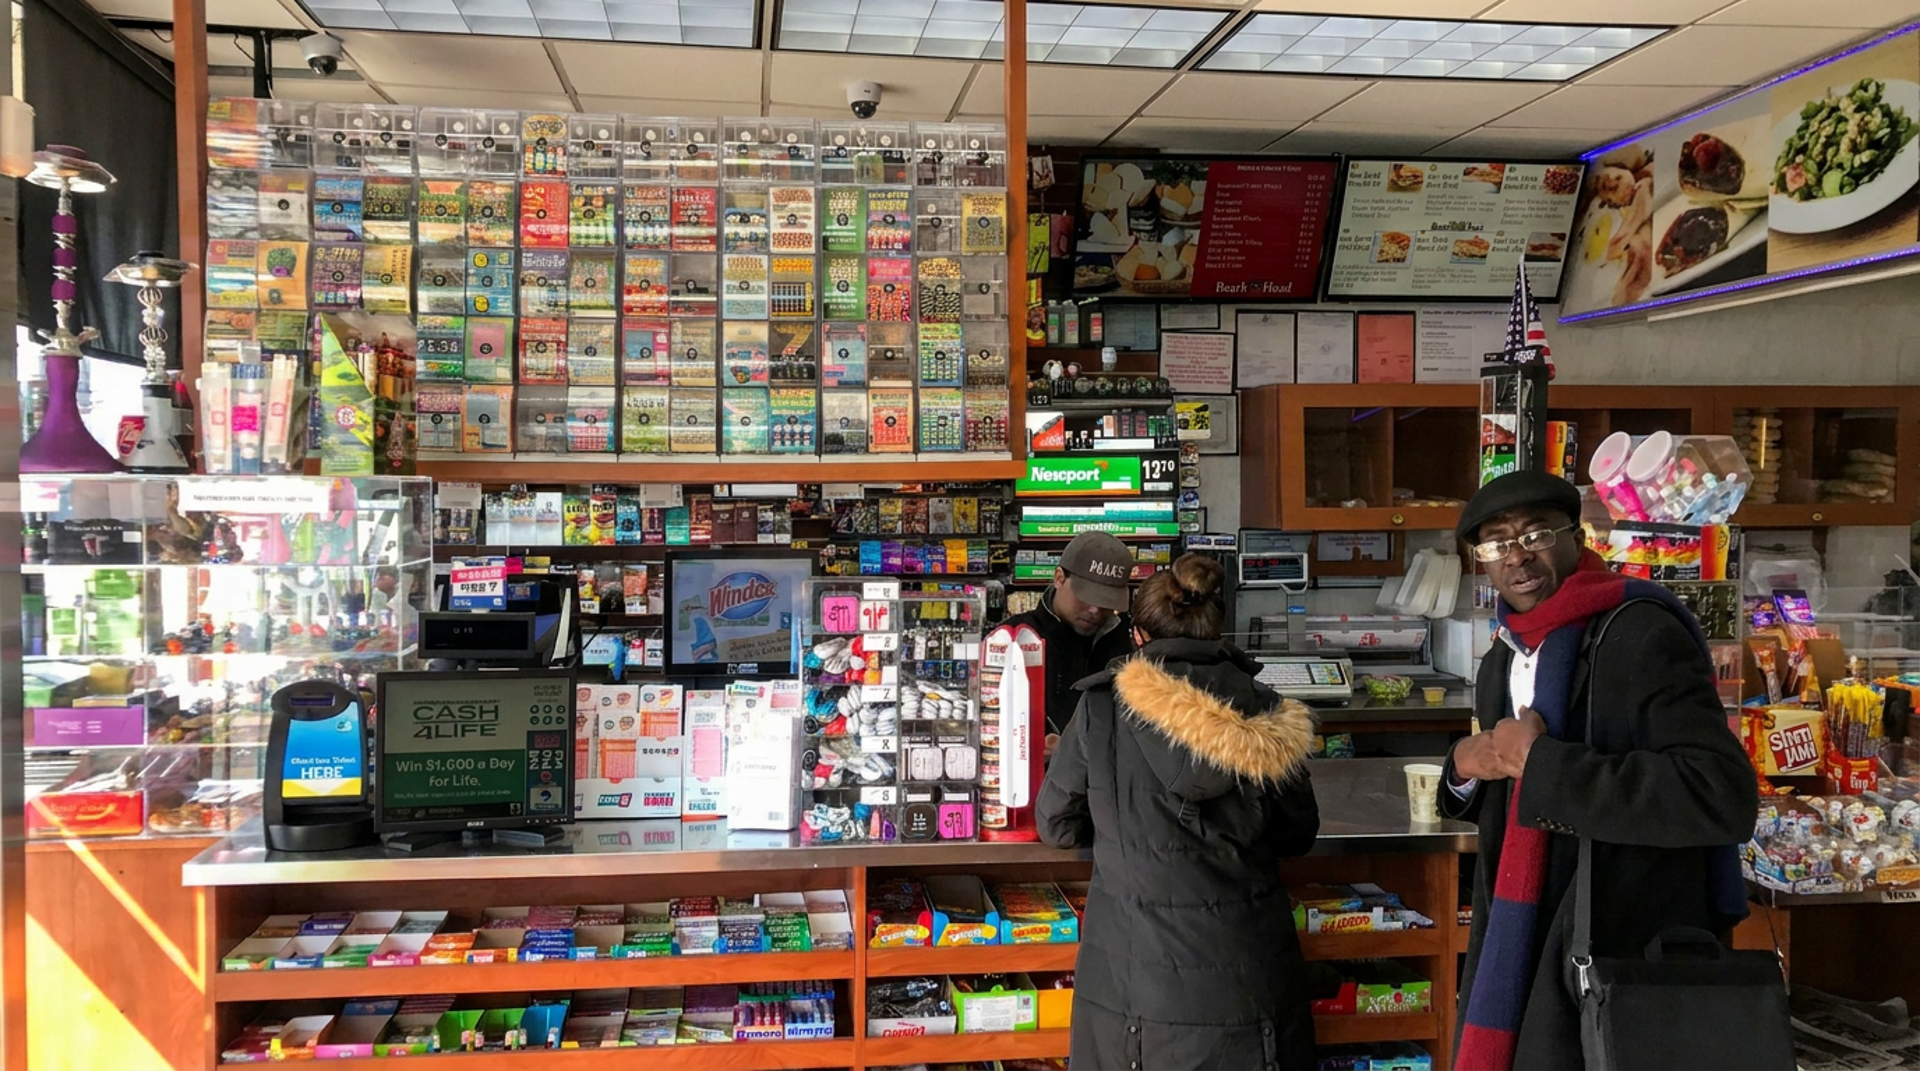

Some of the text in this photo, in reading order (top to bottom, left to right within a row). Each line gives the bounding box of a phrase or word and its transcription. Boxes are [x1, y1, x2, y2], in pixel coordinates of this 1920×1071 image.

[412, 705, 499, 720] CASH
[412, 723, 498, 739] 4LIFE
[395, 761, 423, 772] Win
[429, 775, 449, 787] for
